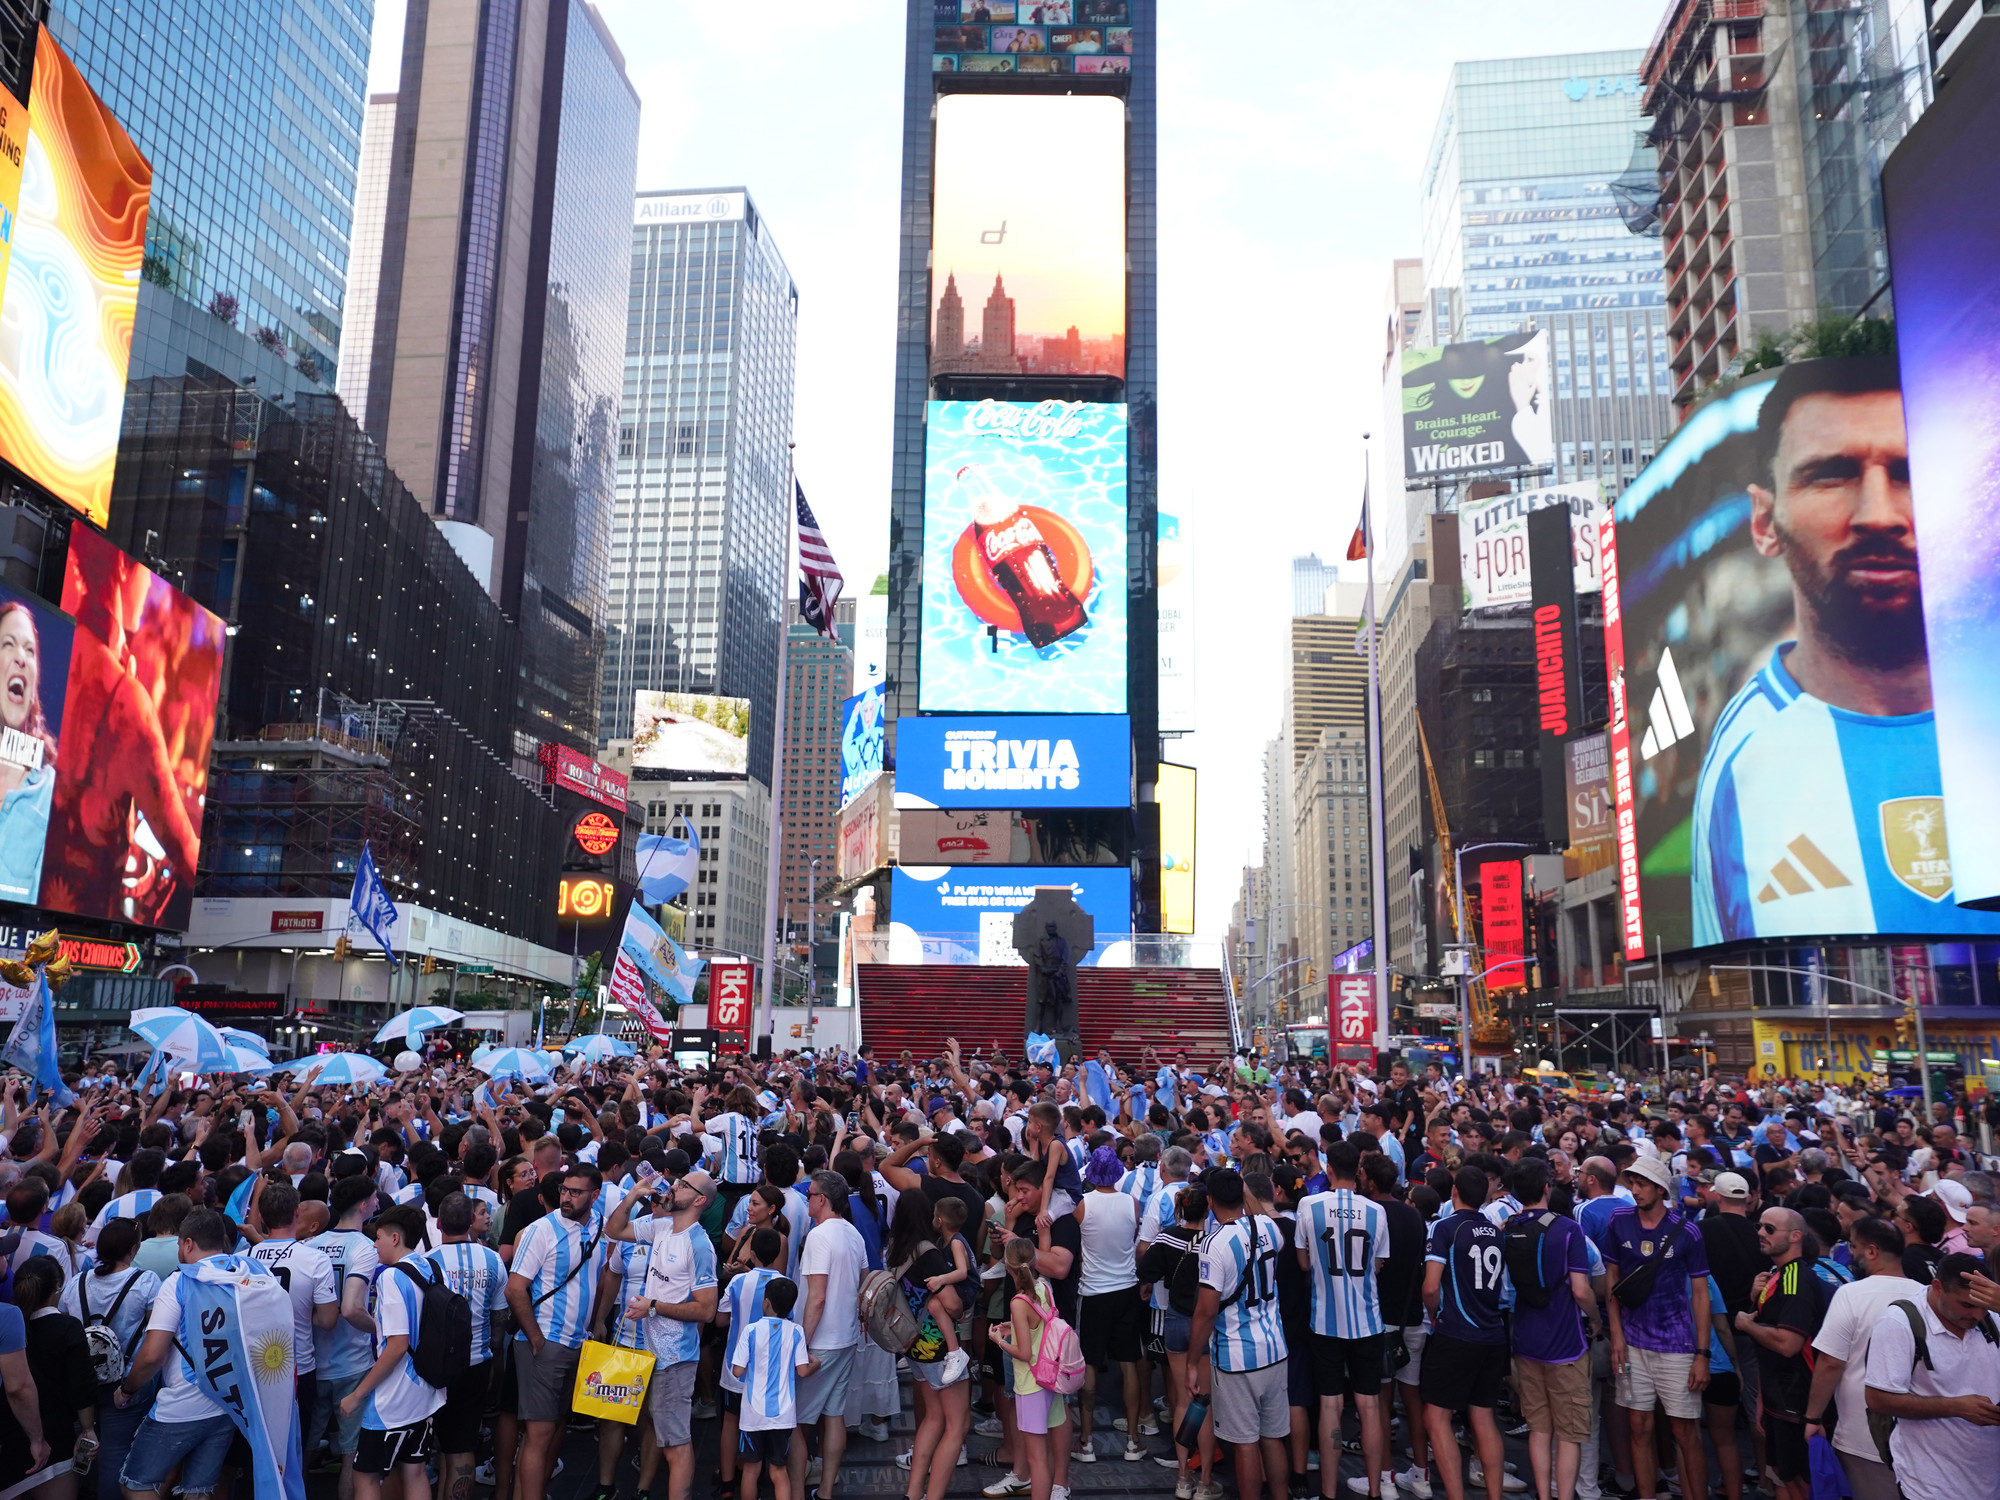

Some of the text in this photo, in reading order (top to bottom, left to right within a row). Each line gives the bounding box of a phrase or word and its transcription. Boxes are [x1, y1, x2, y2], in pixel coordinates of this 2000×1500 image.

[1090, 15, 1117, 23] TIME
[639, 202, 702, 218] Allianz
[963, 398, 1089, 437] Coca-Cola
[1414, 410, 1501, 431] Brains. Heart.
[1430, 425, 1486, 440] Courage.
[1475, 494, 1538, 537] LITTLE
[1475, 524, 1595, 594] HORS
[1602, 549, 1620, 627] STORE
[1534, 604, 1568, 736] JUANCHITO
[944, 739, 1080, 769] TRIVIA
[943, 767, 1080, 790] MOMENTS
[1574, 765, 1609, 785] CELEBRATIO
[1614, 747, 1632, 806] FREE
[601, 778, 625, 799] PLAZA
[588, 816, 608, 825] HOT
[586, 840, 607, 850] NOW
[1910, 859, 1949, 874] FIFA
[1618, 808, 1642, 951] CHOCOLATE
[953, 885, 979, 896] PLAY
[979, 885, 994, 896] TO
[994, 885, 1013, 896] WIN
[1013, 886, 1022, 896] A
[941, 897, 967, 906] FREE
[989, 897, 1005, 907] OR
[278, 917, 317, 928] PATRIOTS
[57, 939, 126, 968] DOS CAMINOS
[631, 947, 677, 999] ARGENTIN
[179, 1000, 278, 1009] KLIX PHOTOGRAPHY
[718, 967, 748, 1025] tkts
[1340, 978, 1370, 1039] tkts
[873, 1179, 885, 1189] SSI
[1329, 1207, 1362, 1220] MESSI
[1472, 1226, 1496, 1238] MESSI
[317, 1246, 346, 1259] MESSI
[1244, 1234, 1269, 1253] MSI
[1320, 1226, 1372, 1277] 10
[255, 1248, 293, 1260] MESSI
[446, 1268, 493, 1280] MPEONES
[1467, 1244, 1502, 1290] 19
[462, 1279, 493, 1289] MUNDO
